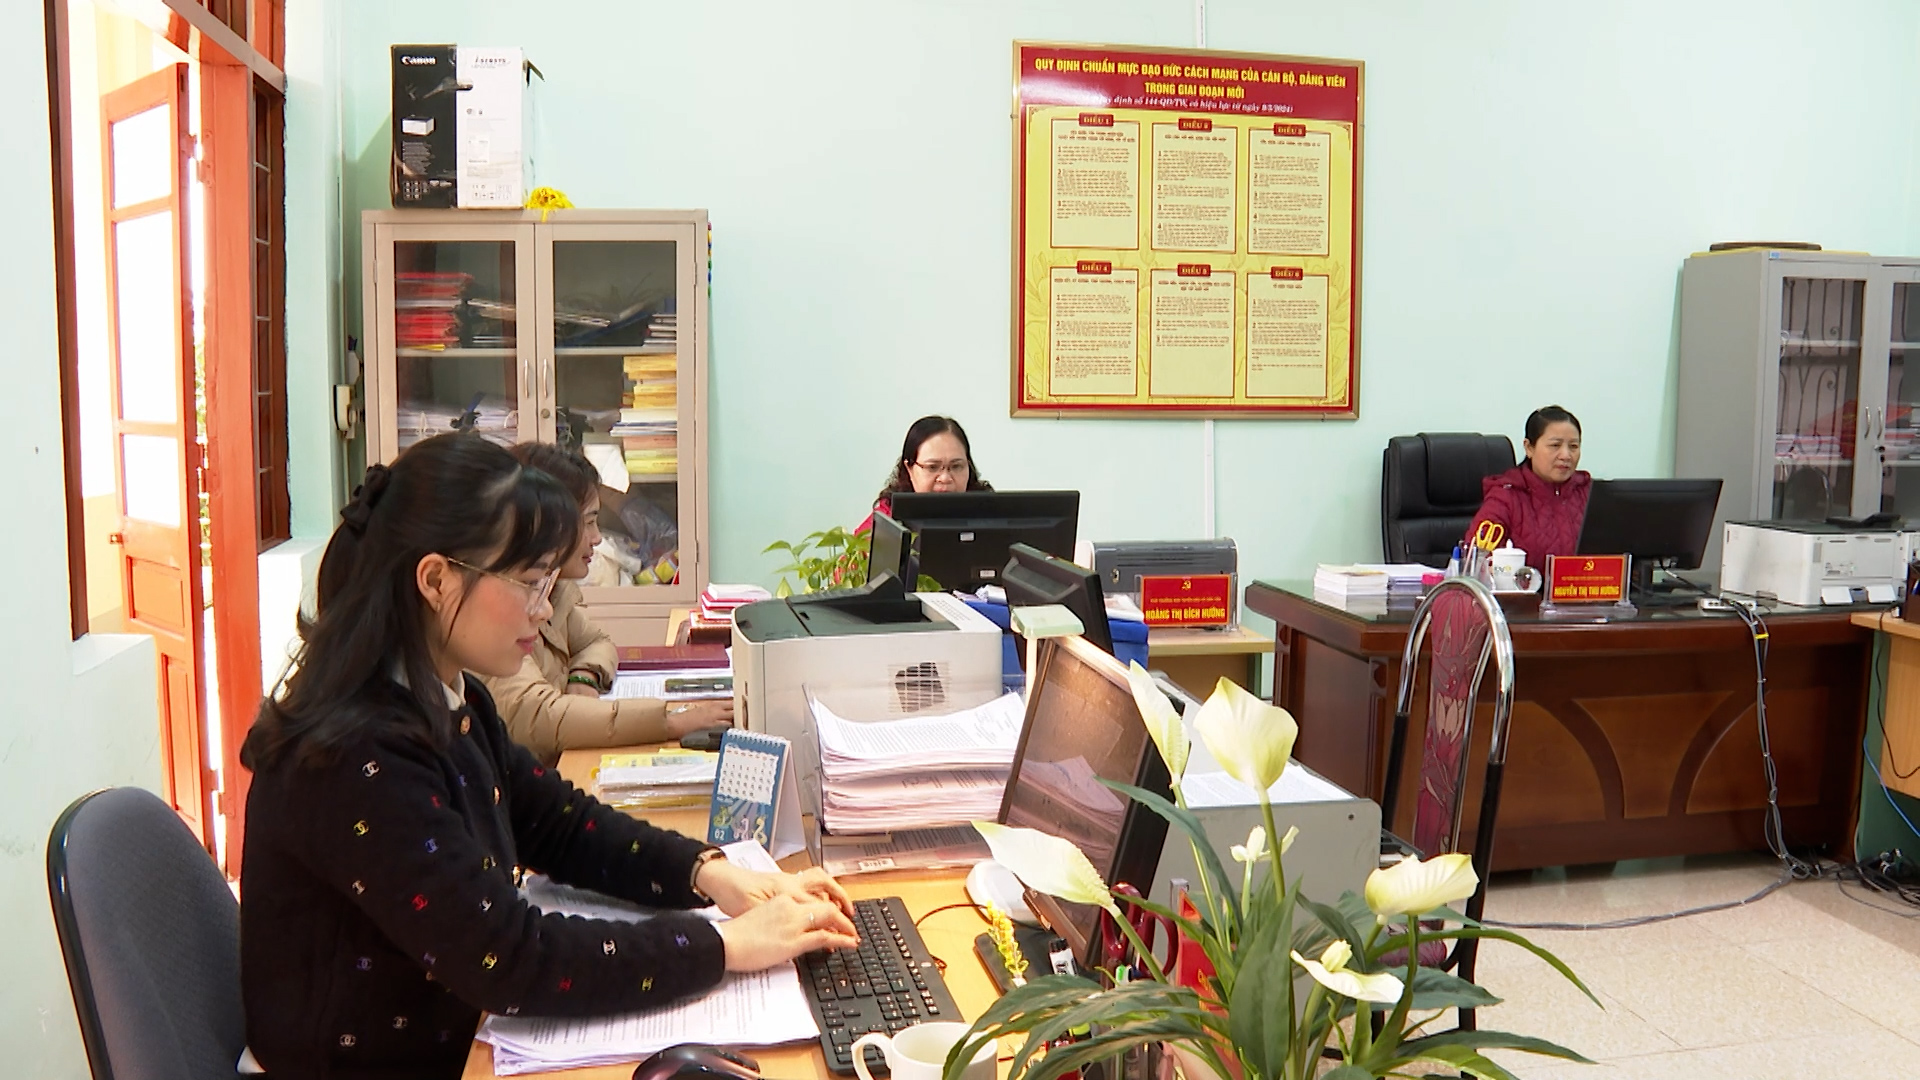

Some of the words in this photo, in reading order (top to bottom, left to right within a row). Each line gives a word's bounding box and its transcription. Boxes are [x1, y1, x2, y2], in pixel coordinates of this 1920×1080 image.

[402, 56, 436, 65] Canon
[1035, 57, 1054, 71] QUY
[1056, 59, 1080, 74] ĐỊNH
[1082, 57, 1115, 73] CHUẨN
[1117, 62, 1139, 77] MỰC
[1141, 64, 1161, 78] ĐẠO
[1163, 62, 1182, 77] ĐỨC
[1184, 64, 1209, 79] CÁCH
[1211, 68, 1239, 82] MẠNG
[1241, 66, 1260, 82] CỦA
[1262, 69, 1280, 83] CÁN
[1283, 70, 1298, 87] BỘ,
[1299, 71, 1324, 87] ĐẢNG
[1326, 74, 1346, 88] VIÊN
[1144, 82, 1176, 95] TRONG
[1178, 84, 1197, 95] GIAI
[1198, 84, 1224, 99] ĐOẠN
[1226, 85, 1245, 99] MỚI
[1146, 607, 1170, 620] HOÀNG
[1171, 609, 1182, 620] THỊ
[1184, 607, 1200, 619] BÍCH
[714, 828, 725, 840] 02
